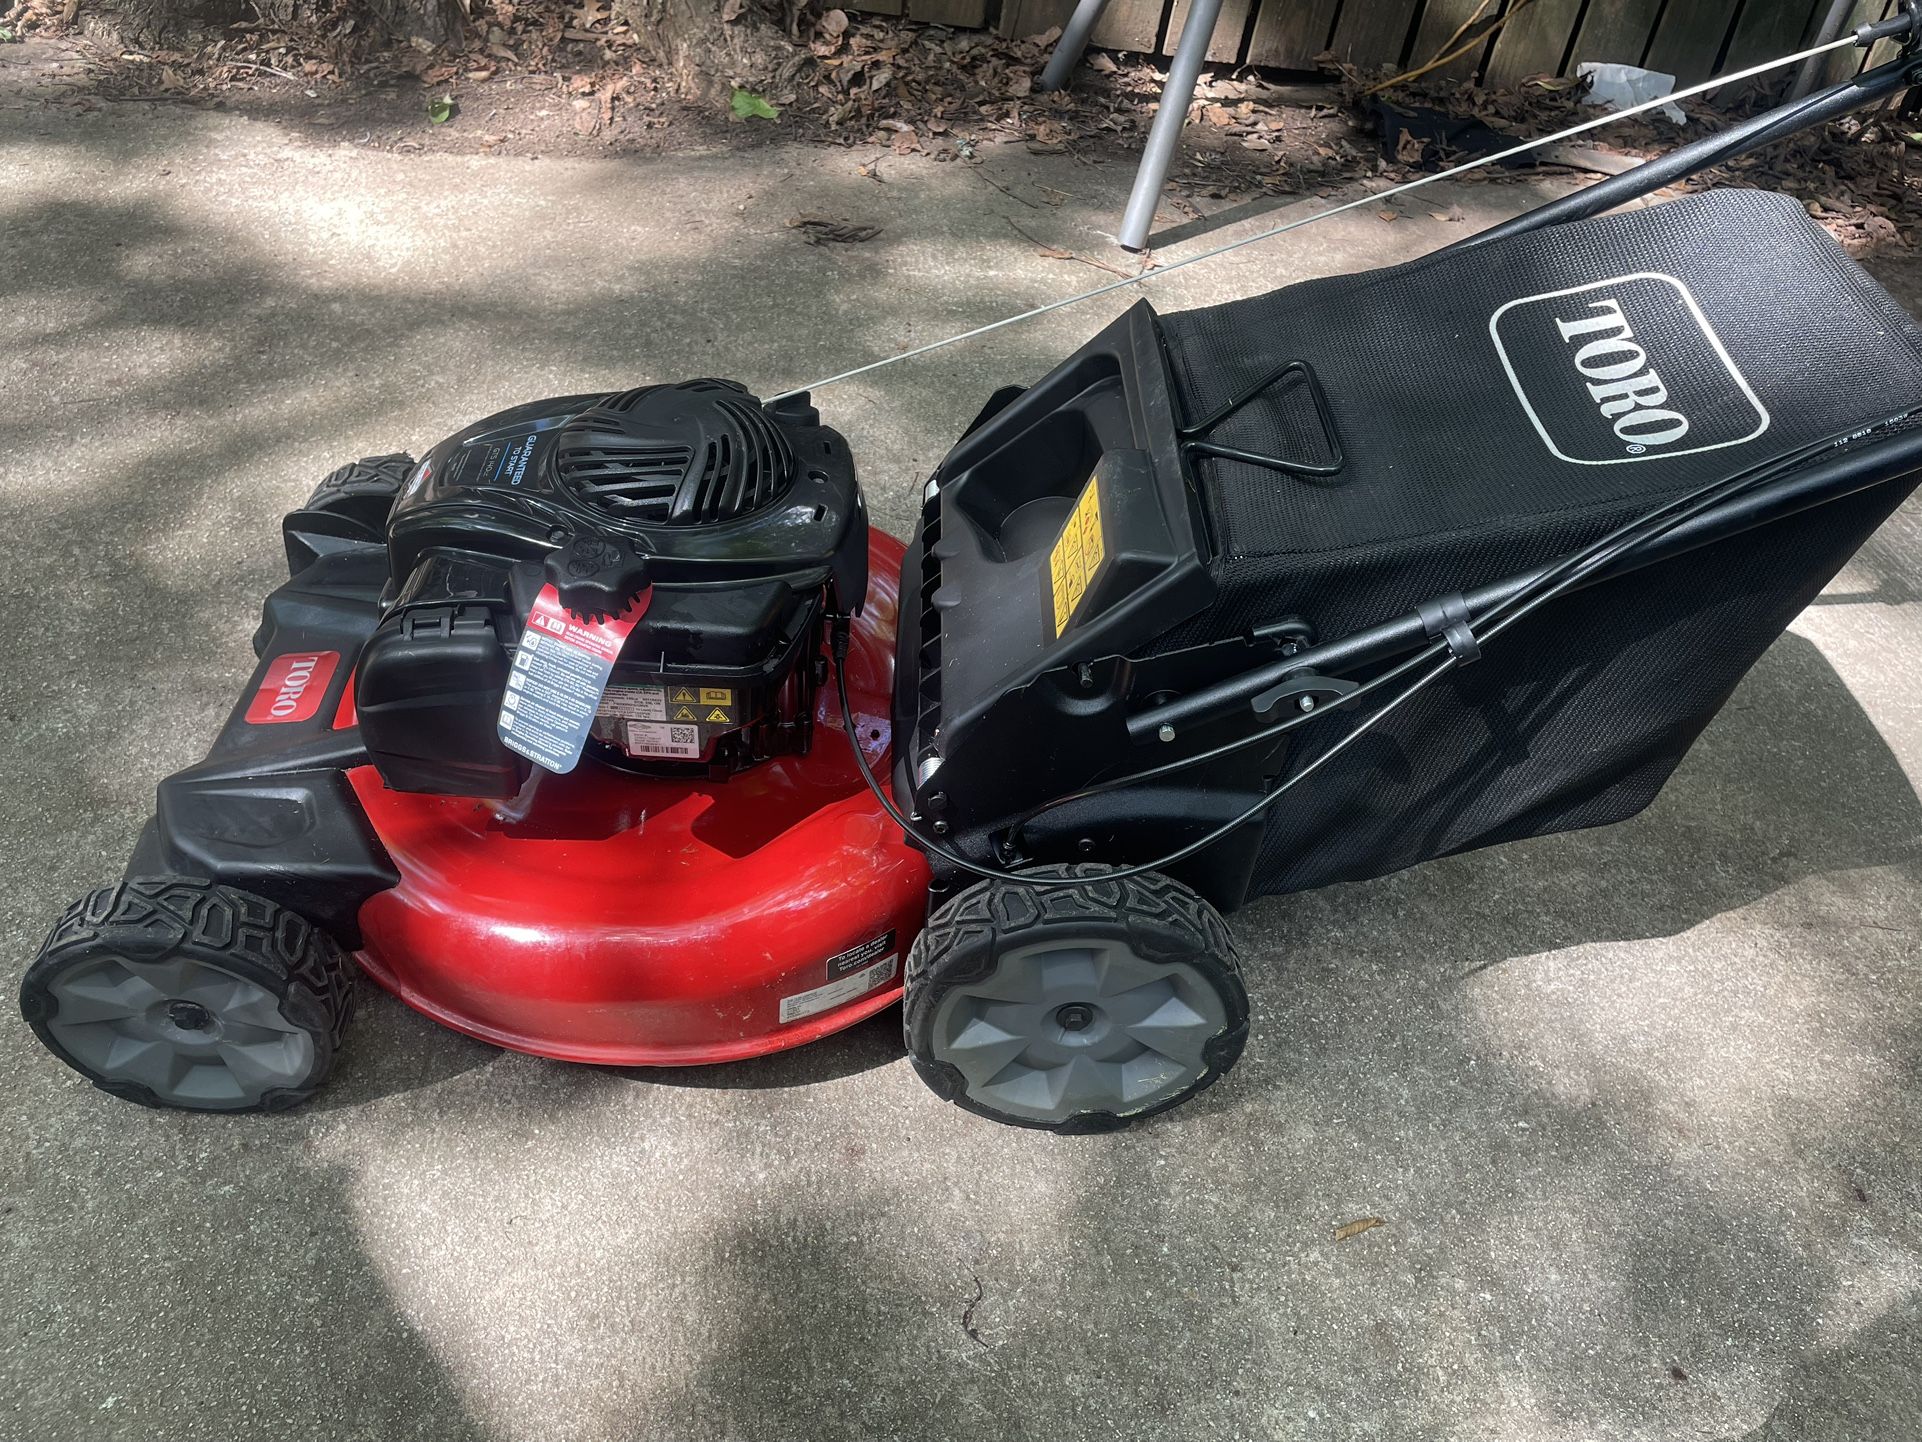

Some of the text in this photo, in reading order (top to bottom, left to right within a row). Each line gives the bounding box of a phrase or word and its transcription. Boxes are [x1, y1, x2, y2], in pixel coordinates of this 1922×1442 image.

[1556, 299, 1689, 446] TORO
[504, 446, 523, 477] TO START
[511, 435, 537, 485] GUARANTEED
[568, 624, 612, 647] WARNING
[271, 657, 318, 716] TORO
